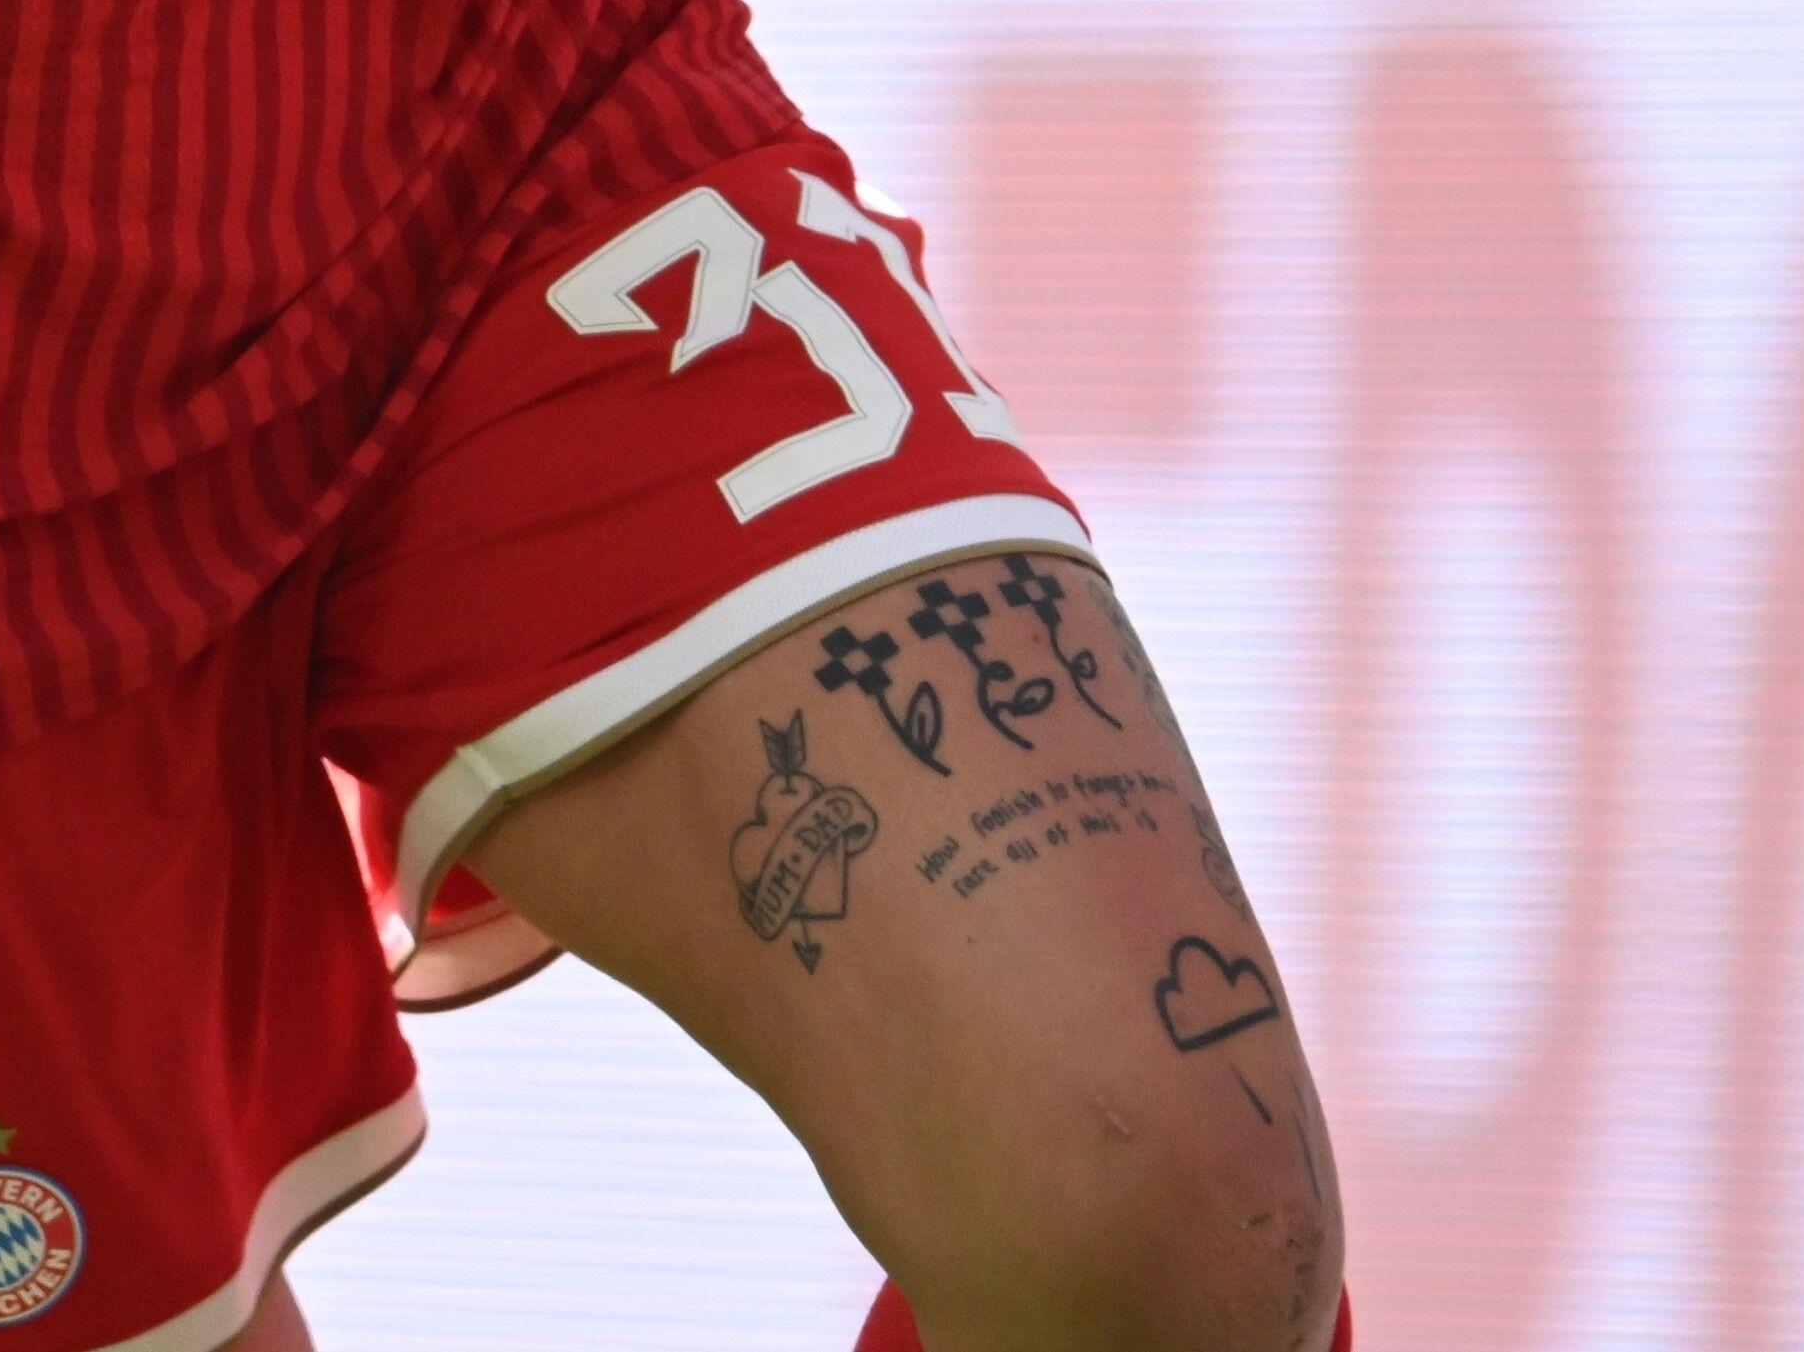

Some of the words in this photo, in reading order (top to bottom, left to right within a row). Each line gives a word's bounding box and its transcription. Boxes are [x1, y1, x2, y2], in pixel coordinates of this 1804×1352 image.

[545, 167, 1022, 524] 31
[1006, 838, 1038, 862] all
[1046, 821, 1069, 847] of
[1079, 808, 1121, 835] this
